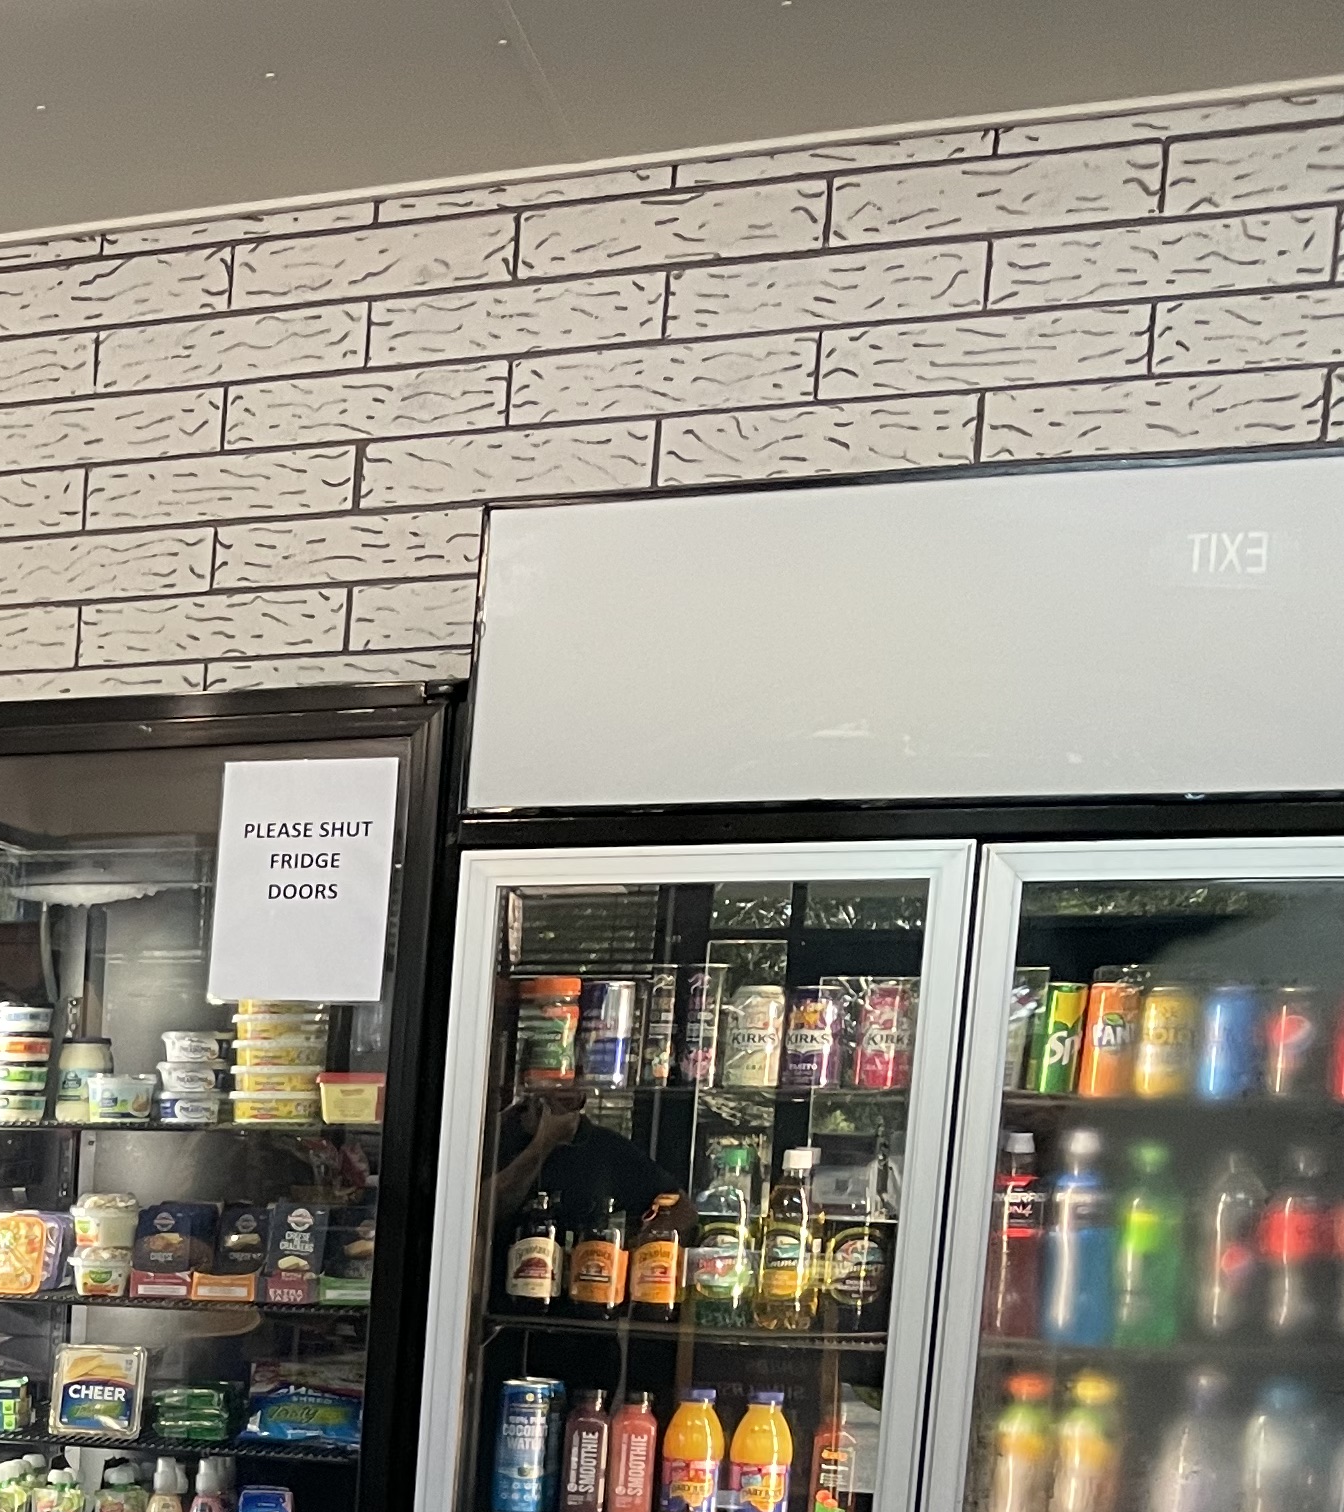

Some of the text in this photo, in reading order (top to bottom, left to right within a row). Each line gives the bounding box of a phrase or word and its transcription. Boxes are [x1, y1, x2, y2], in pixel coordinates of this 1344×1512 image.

[244, 820, 373, 838] PLEASE SHUT
[269, 852, 341, 869] FRIDGE
[268, 883, 338, 900] DOORS
[731, 1032, 776, 1045] KIRKS
[786, 1032, 830, 1044] KIRKS
[69, 1384, 127, 1402] CHEER
[579, 1431, 599, 1493] SMOOTHIE
[627, 1433, 648, 1495] SMOOTHIE
